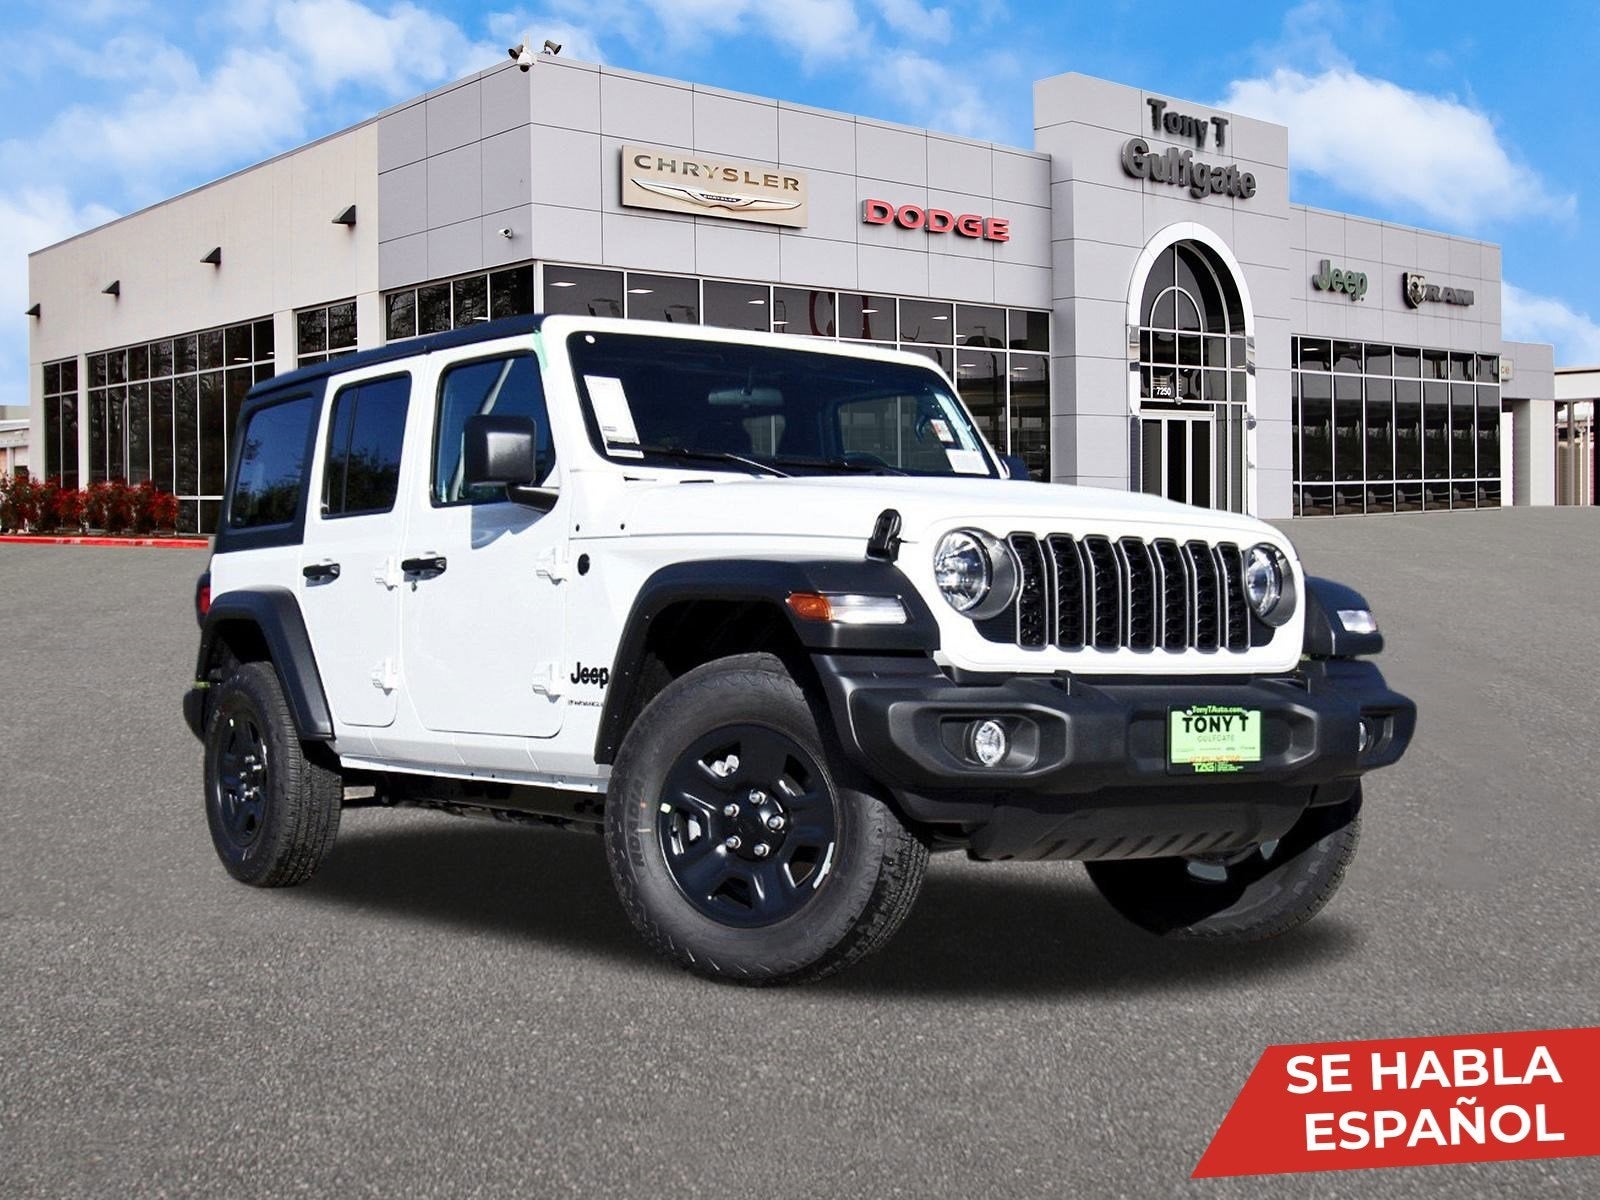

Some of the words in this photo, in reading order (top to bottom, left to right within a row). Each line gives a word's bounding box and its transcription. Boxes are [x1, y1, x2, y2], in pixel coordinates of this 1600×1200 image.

[1147, 98, 1208, 147] Tony
[1211, 117, 1228, 147] T
[633, 154, 800, 192] CHRYSLER
[1121, 138, 1256, 199] Gulfgate
[862, 199, 1010, 242] DODGE
[1312, 259, 1368, 302] Jeep
[1425, 284, 1475, 306] RAM
[570, 661, 609, 689] Jeep
[1182, 716, 1233, 733] TONY
[1239, 715, 1249, 732] T
